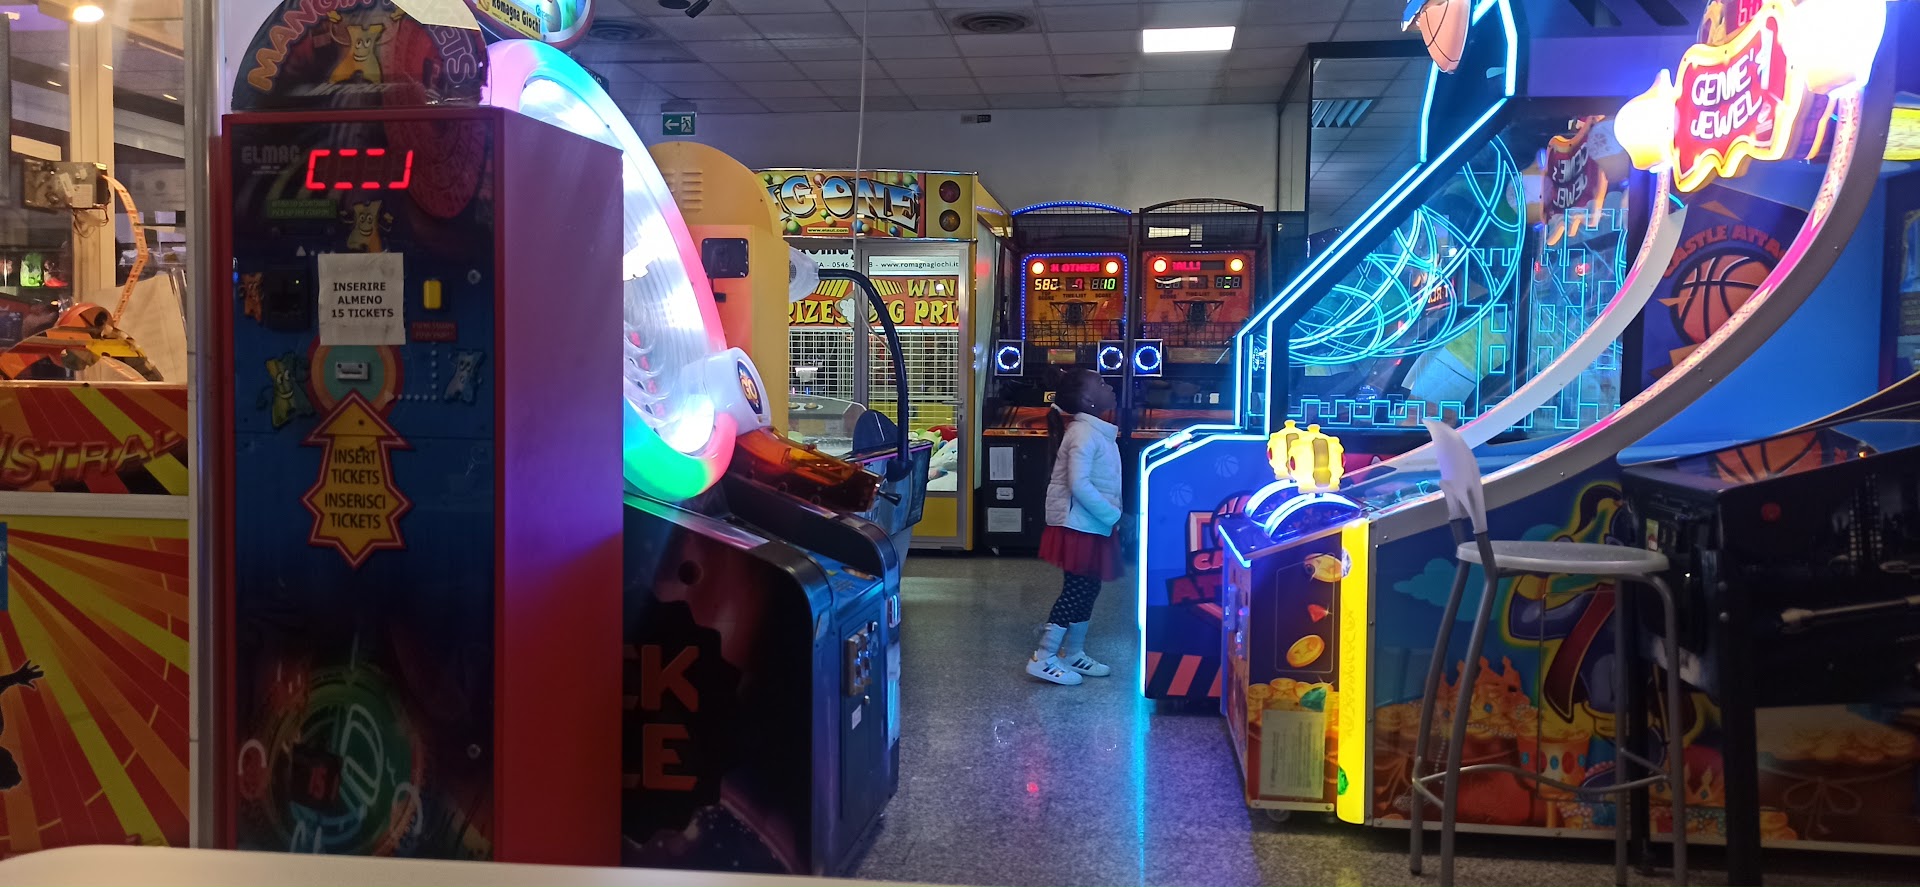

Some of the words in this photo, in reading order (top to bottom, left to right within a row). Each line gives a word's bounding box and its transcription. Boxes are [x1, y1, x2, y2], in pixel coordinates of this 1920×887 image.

[522, 10, 541, 34] Giochi
[1691, 91, 1762, 140] JEWEL
[822, 175, 920, 234] ONE
[1664, 225, 1728, 278] ASTLE
[881, 261, 959, 269] www.romagnagiochi.it
[333, 282, 386, 291] INSERIRE
[907, 278, 956, 298] WIN
[338, 295, 382, 304] ALMENO
[332, 308, 344, 318] 15
[348, 308, 394, 318] TICKETS
[334, 448, 377, 464] INSERT
[331, 468, 380, 485] TICKETS
[324, 493, 386, 510] INSERISCI
[330, 512, 381, 530] TICKETS
